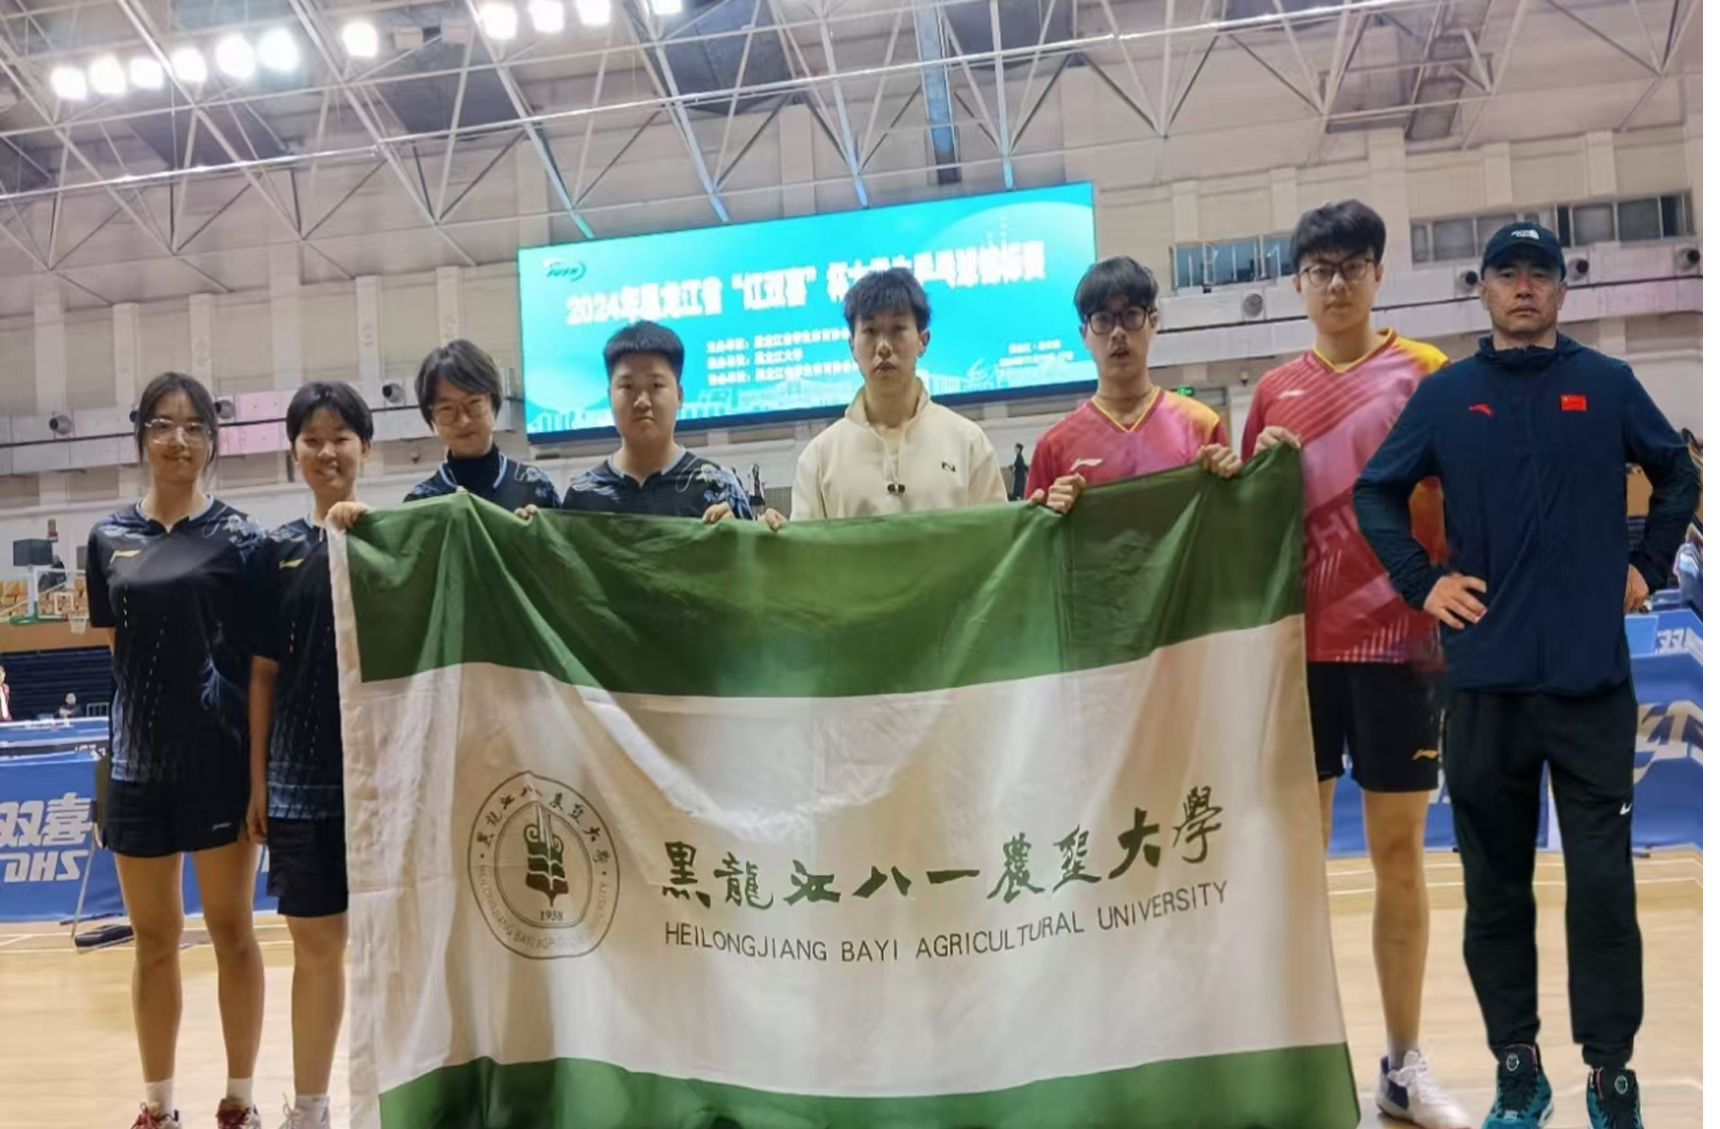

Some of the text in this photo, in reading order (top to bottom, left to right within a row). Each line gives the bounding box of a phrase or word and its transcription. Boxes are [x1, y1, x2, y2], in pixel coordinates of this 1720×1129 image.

[0, 850, 90, 883] DHS
[539, 910, 564, 922] 1958
[665, 880, 1227, 962] HEILONGJIANG BAYI AGRICULTURAL UNIVERSITY
